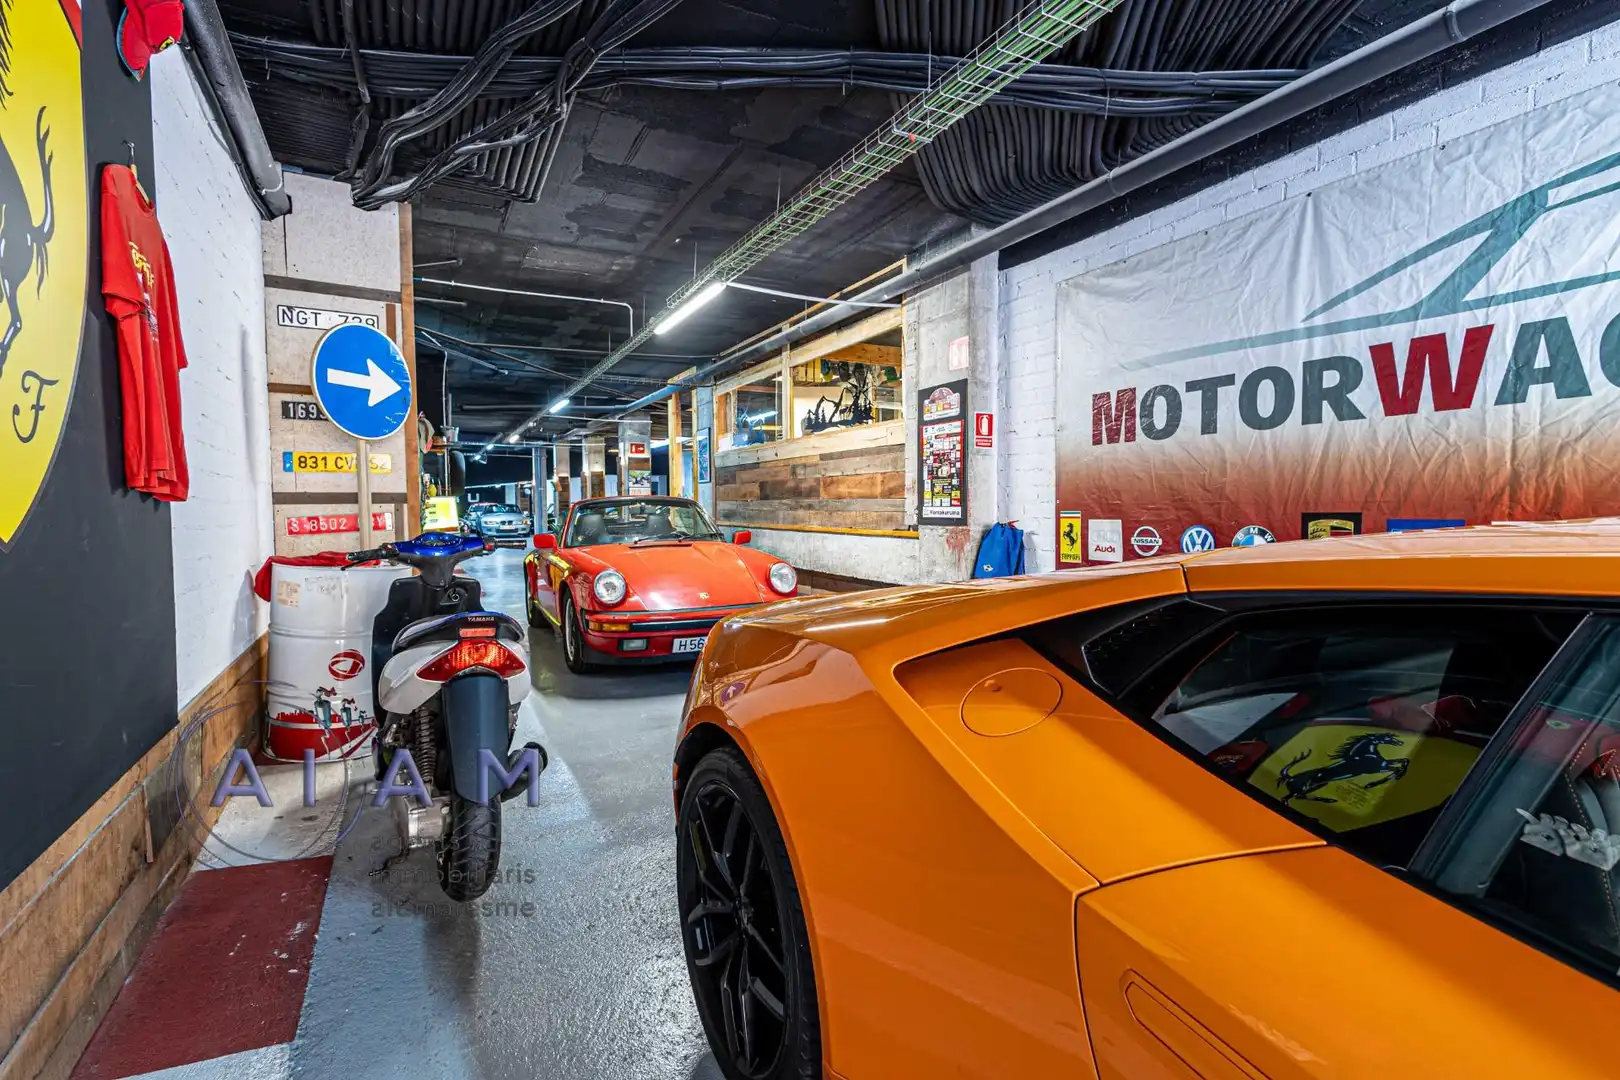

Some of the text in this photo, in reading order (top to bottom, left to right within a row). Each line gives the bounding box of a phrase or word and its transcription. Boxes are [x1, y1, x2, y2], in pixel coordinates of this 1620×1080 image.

[281, 308, 321, 326] NGT
[1092, 315, 1620, 446] MOTORWA
[288, 402, 327, 419] 169
[298, 455, 328, 469] 831
[335, 456, 358, 470] CV
[1236, 527, 1273, 541] BMW
[1094, 544, 1116, 553] Audi
